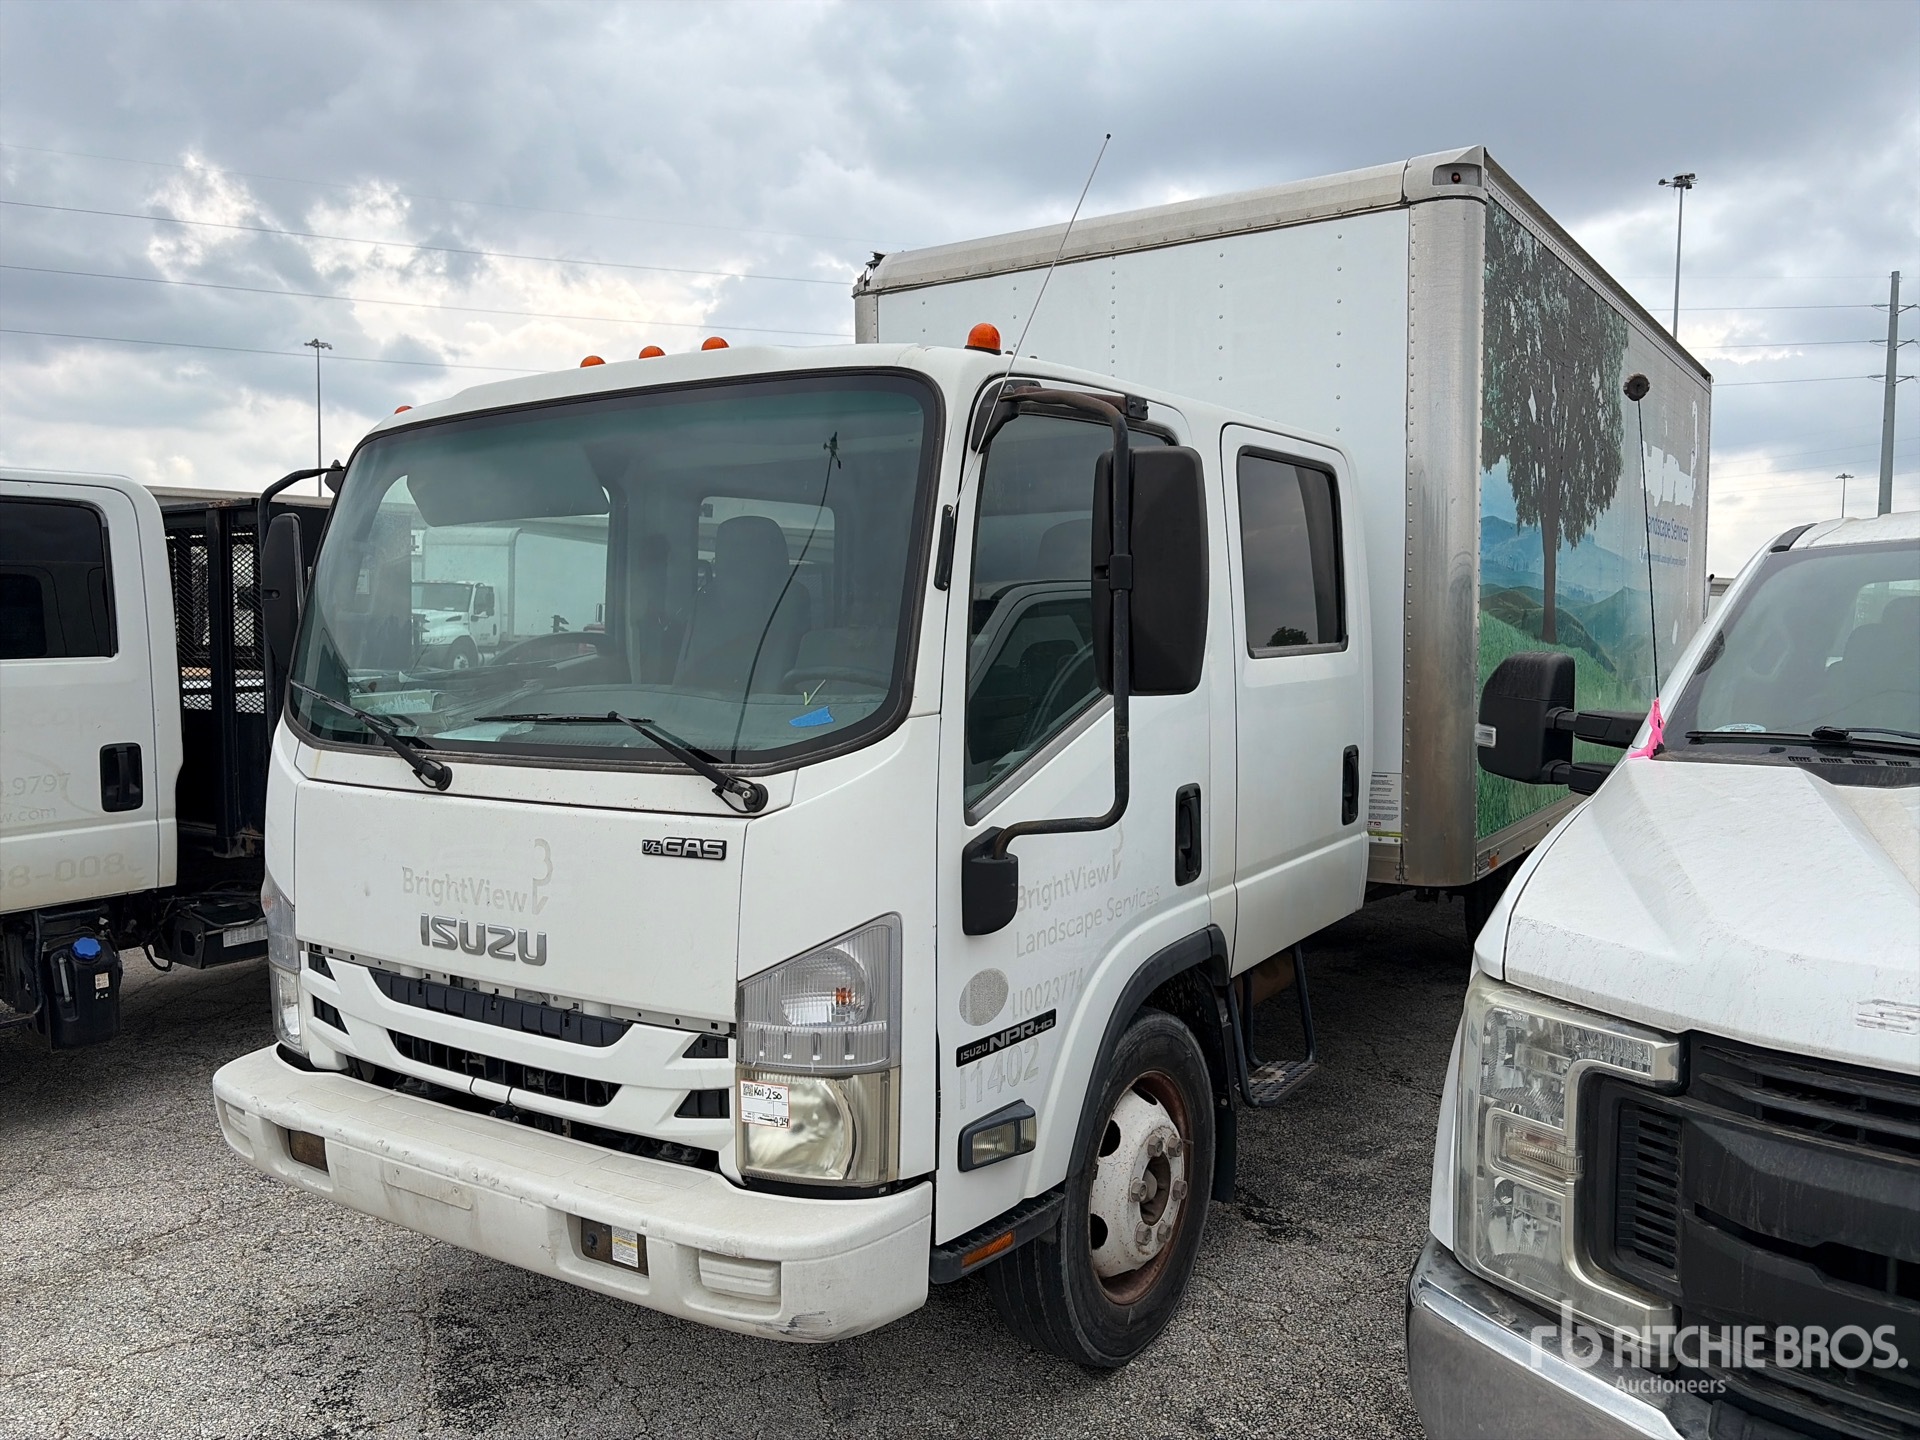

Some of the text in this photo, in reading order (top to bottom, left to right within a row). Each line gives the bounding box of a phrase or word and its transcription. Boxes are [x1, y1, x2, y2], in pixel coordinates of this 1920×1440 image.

[1645, 512, 1671, 544] andscape
[662, 838, 724, 859] GAS
[402, 865, 527, 912] BrightView
[1018, 861, 1111, 913] BrightView
[420, 912, 547, 967] ISUZU
[1016, 885, 1161, 958] Landscape Services
[960, 1042, 988, 1061] ISUZU
